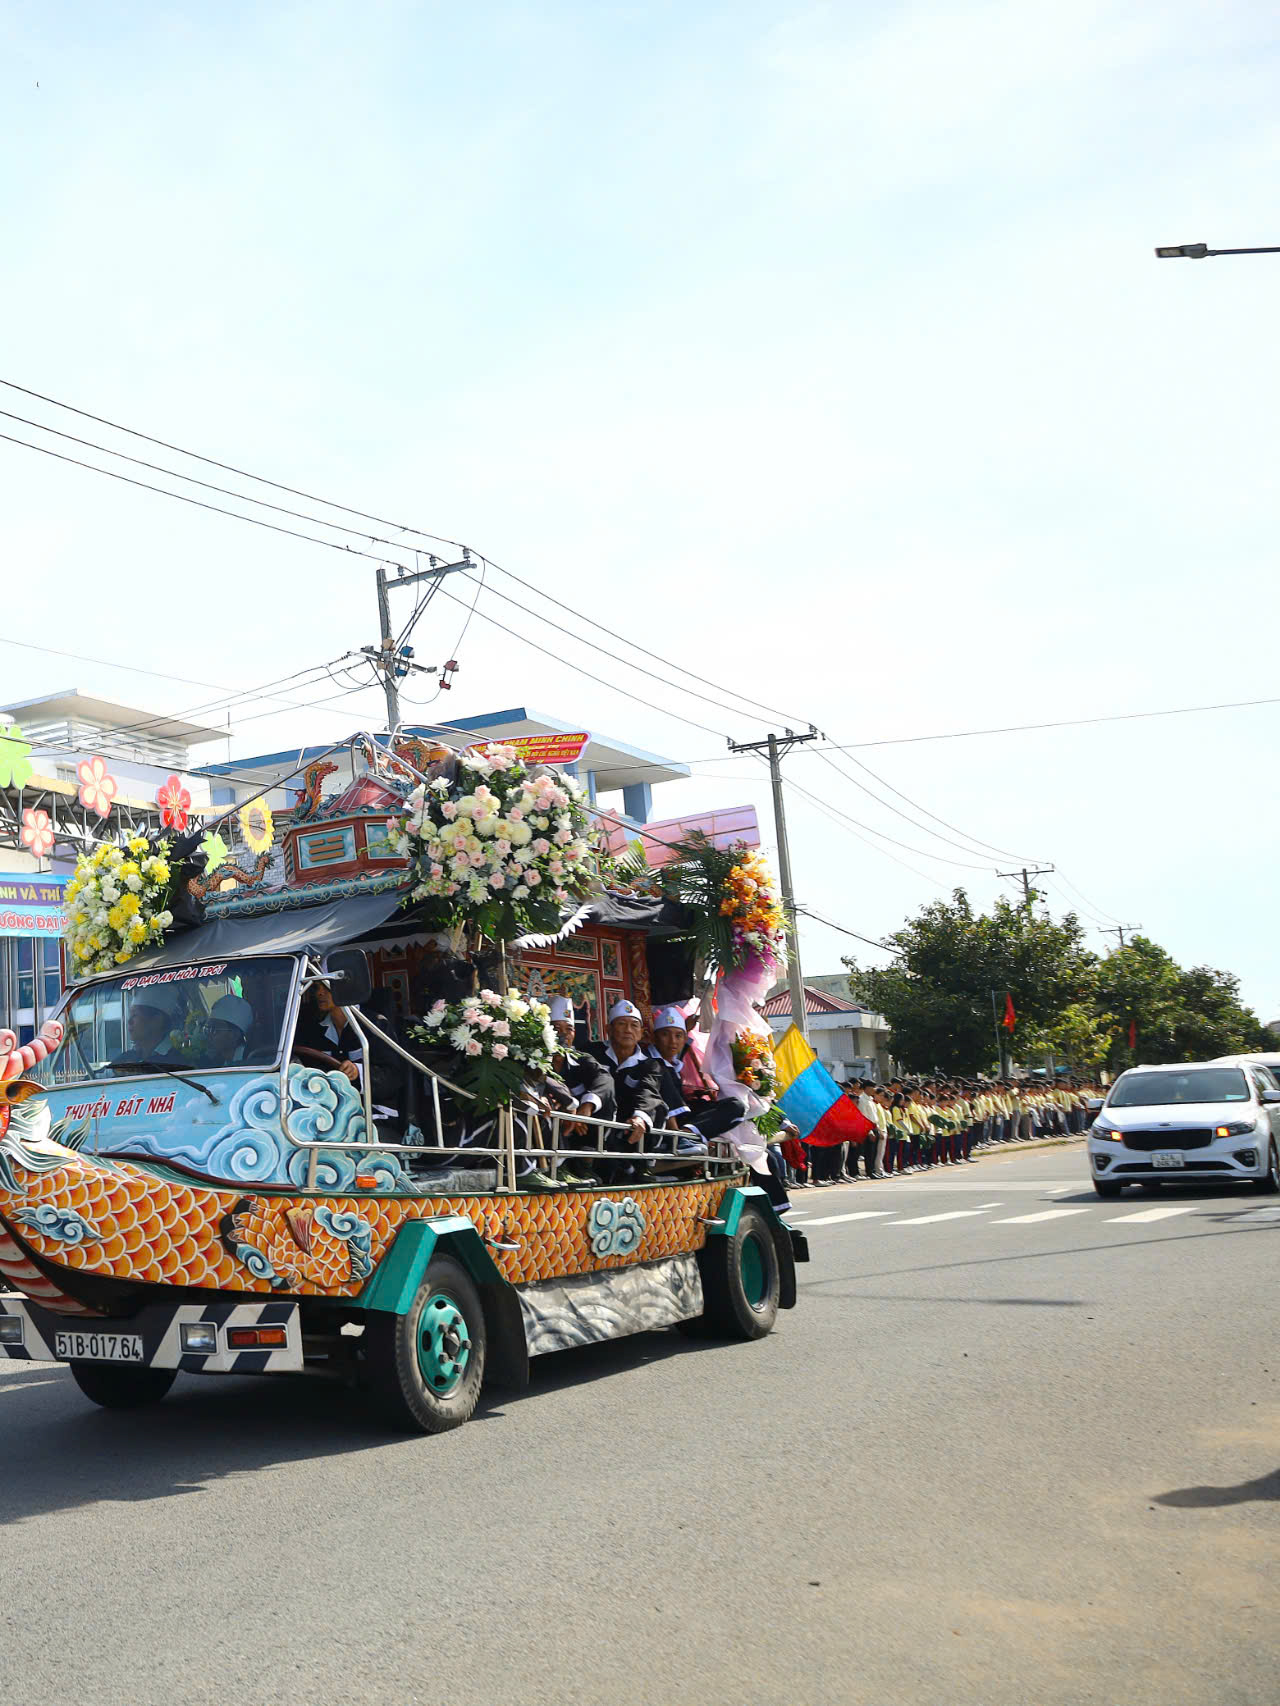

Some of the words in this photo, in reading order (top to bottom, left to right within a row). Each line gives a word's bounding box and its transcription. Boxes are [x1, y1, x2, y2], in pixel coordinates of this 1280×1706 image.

[20, 884, 38, 901] VÀ
[39, 886, 61, 902] THÍ
[36, 915, 59, 933] ĐẠI
[158, 972, 176, 983] AN
[198, 964, 228, 977] TPCT
[57, 1334, 140, 1359] 51B-017.64
